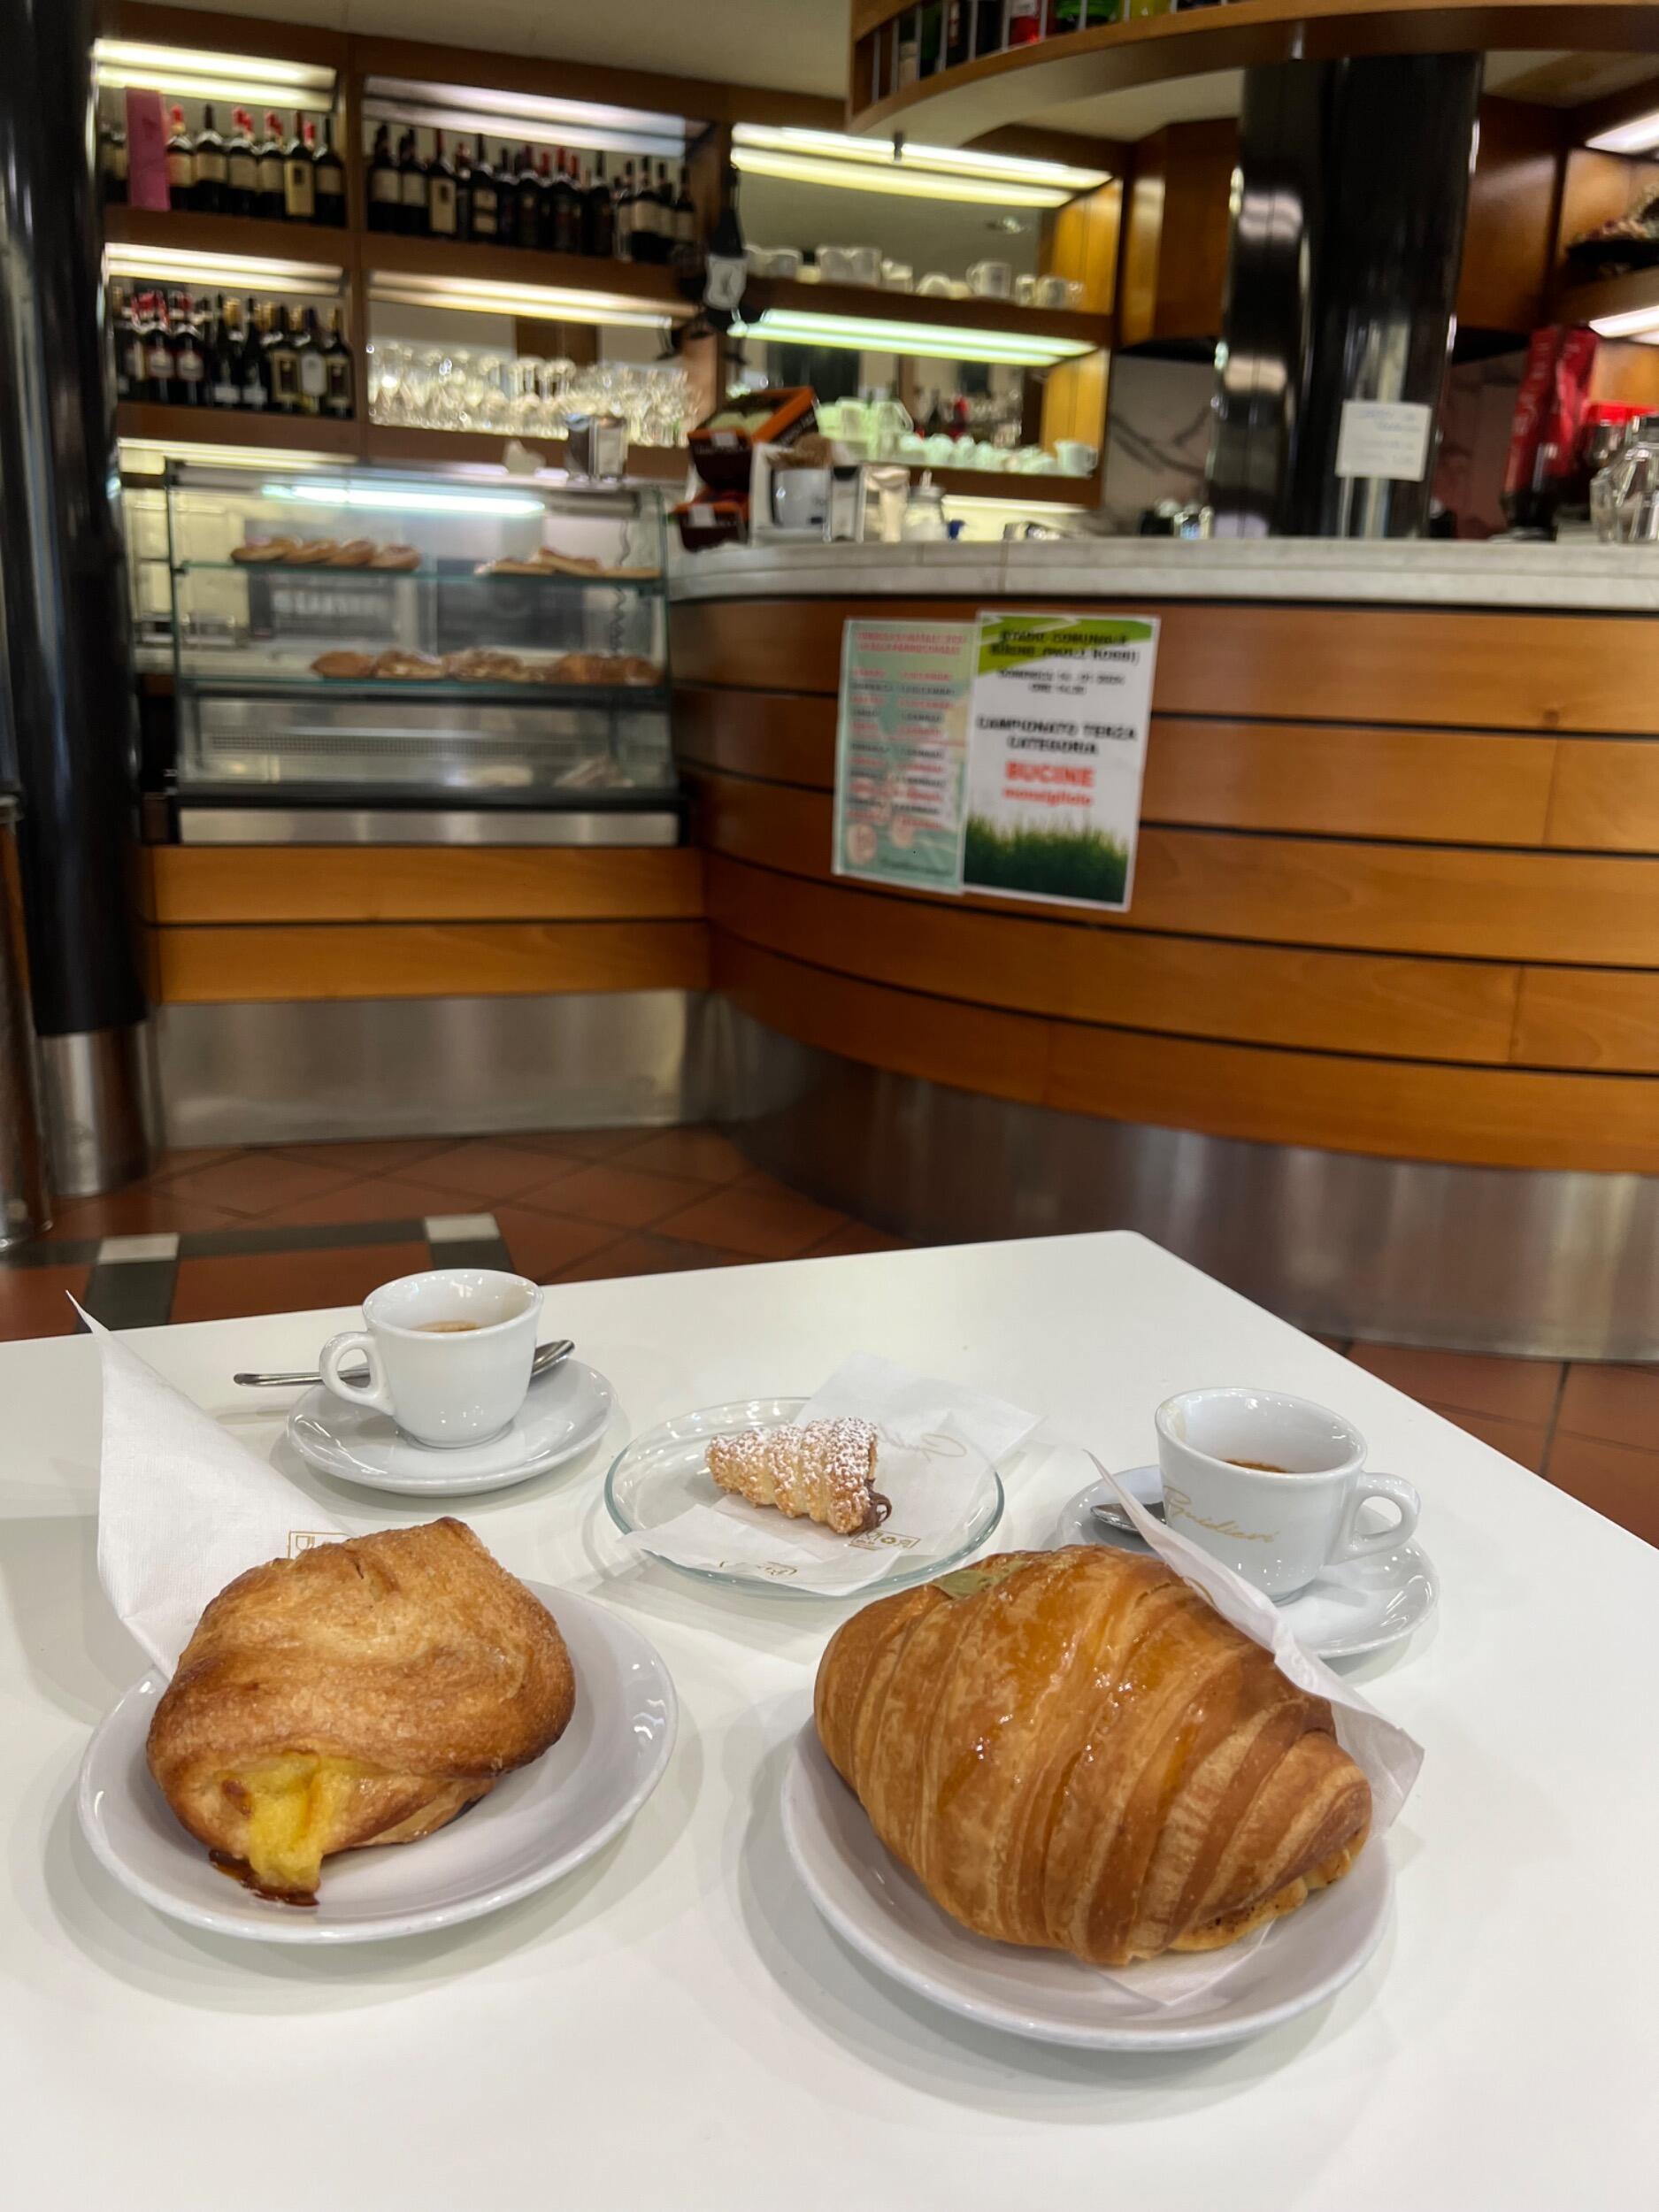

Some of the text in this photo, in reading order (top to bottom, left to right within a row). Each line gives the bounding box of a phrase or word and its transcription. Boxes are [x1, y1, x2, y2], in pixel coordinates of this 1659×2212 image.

[978, 717, 1137, 741] CAMPIONATO TERZA
[1007, 736, 1098, 754] CATEGORIA
[1005, 762, 1094, 787] BUCINE
